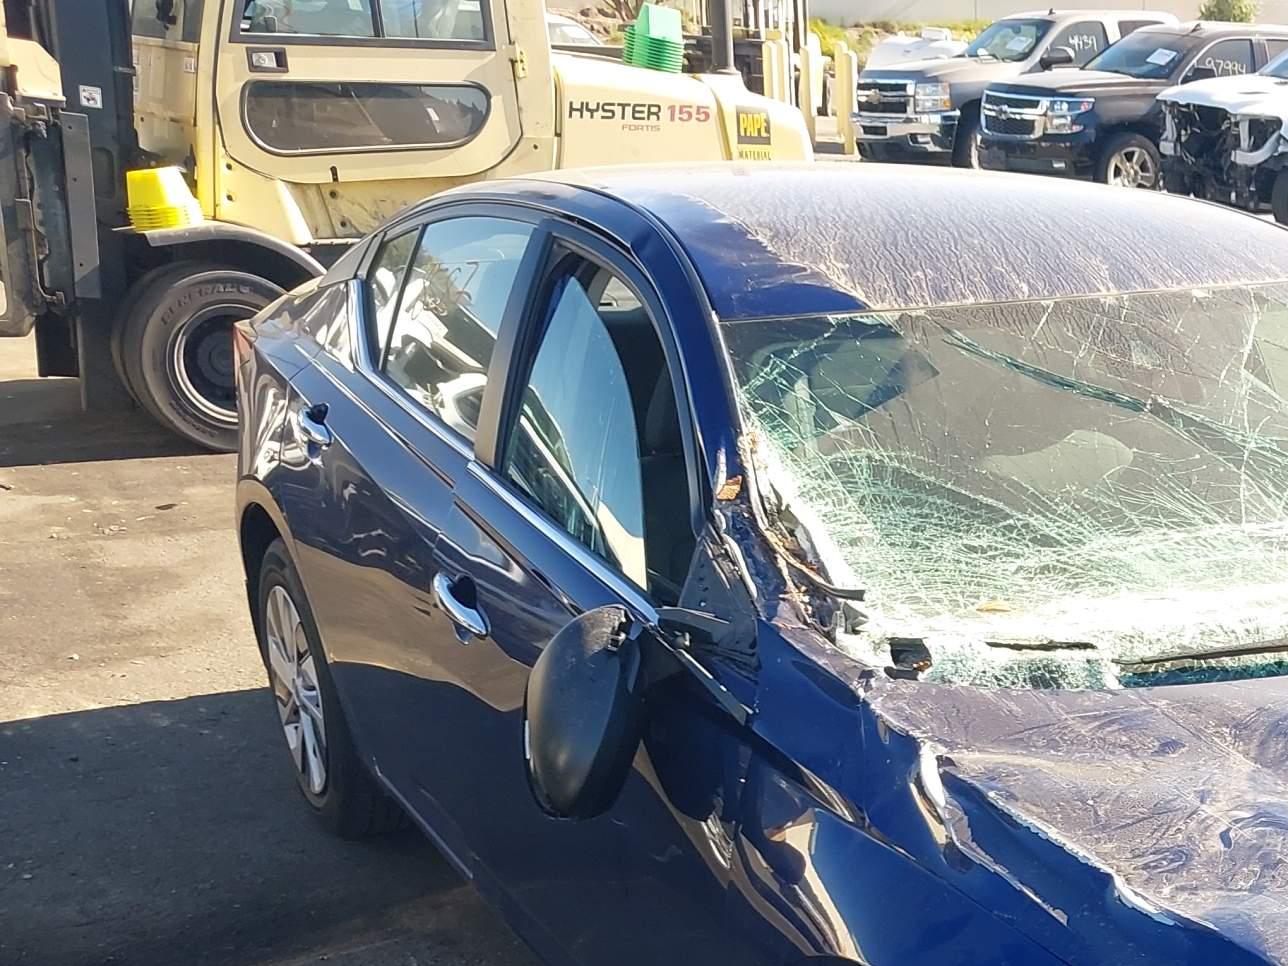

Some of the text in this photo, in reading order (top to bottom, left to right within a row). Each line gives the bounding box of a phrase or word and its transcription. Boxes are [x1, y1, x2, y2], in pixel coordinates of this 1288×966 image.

[569, 101, 710, 121] HYSTER 155
[622, 124, 660, 132] FORTIS
[738, 150, 771, 161] MATERIAL
